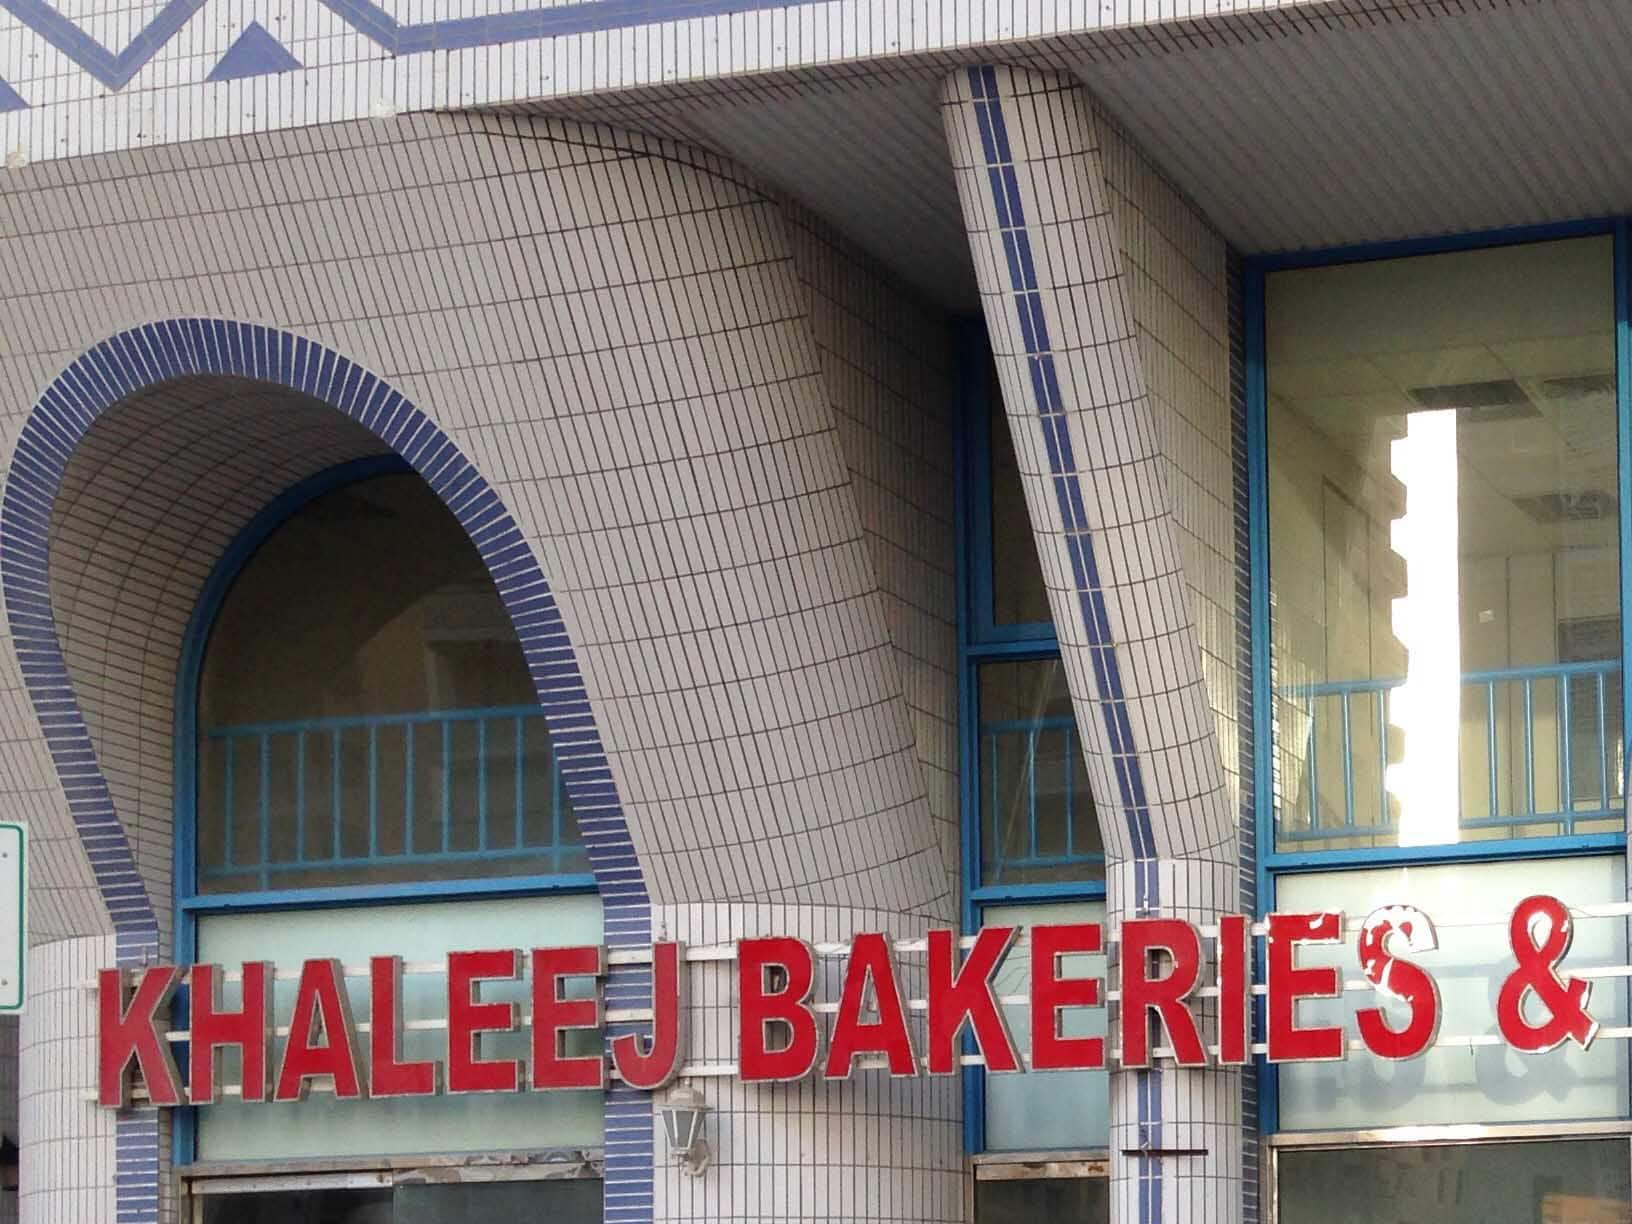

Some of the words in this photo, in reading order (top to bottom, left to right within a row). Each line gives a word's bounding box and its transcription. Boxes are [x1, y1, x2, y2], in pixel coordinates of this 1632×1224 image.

[98, 941, 687, 1107] KHALEEJ
[737, 904, 1442, 1083] BAKERIES
[1497, 894, 1599, 1054] &
